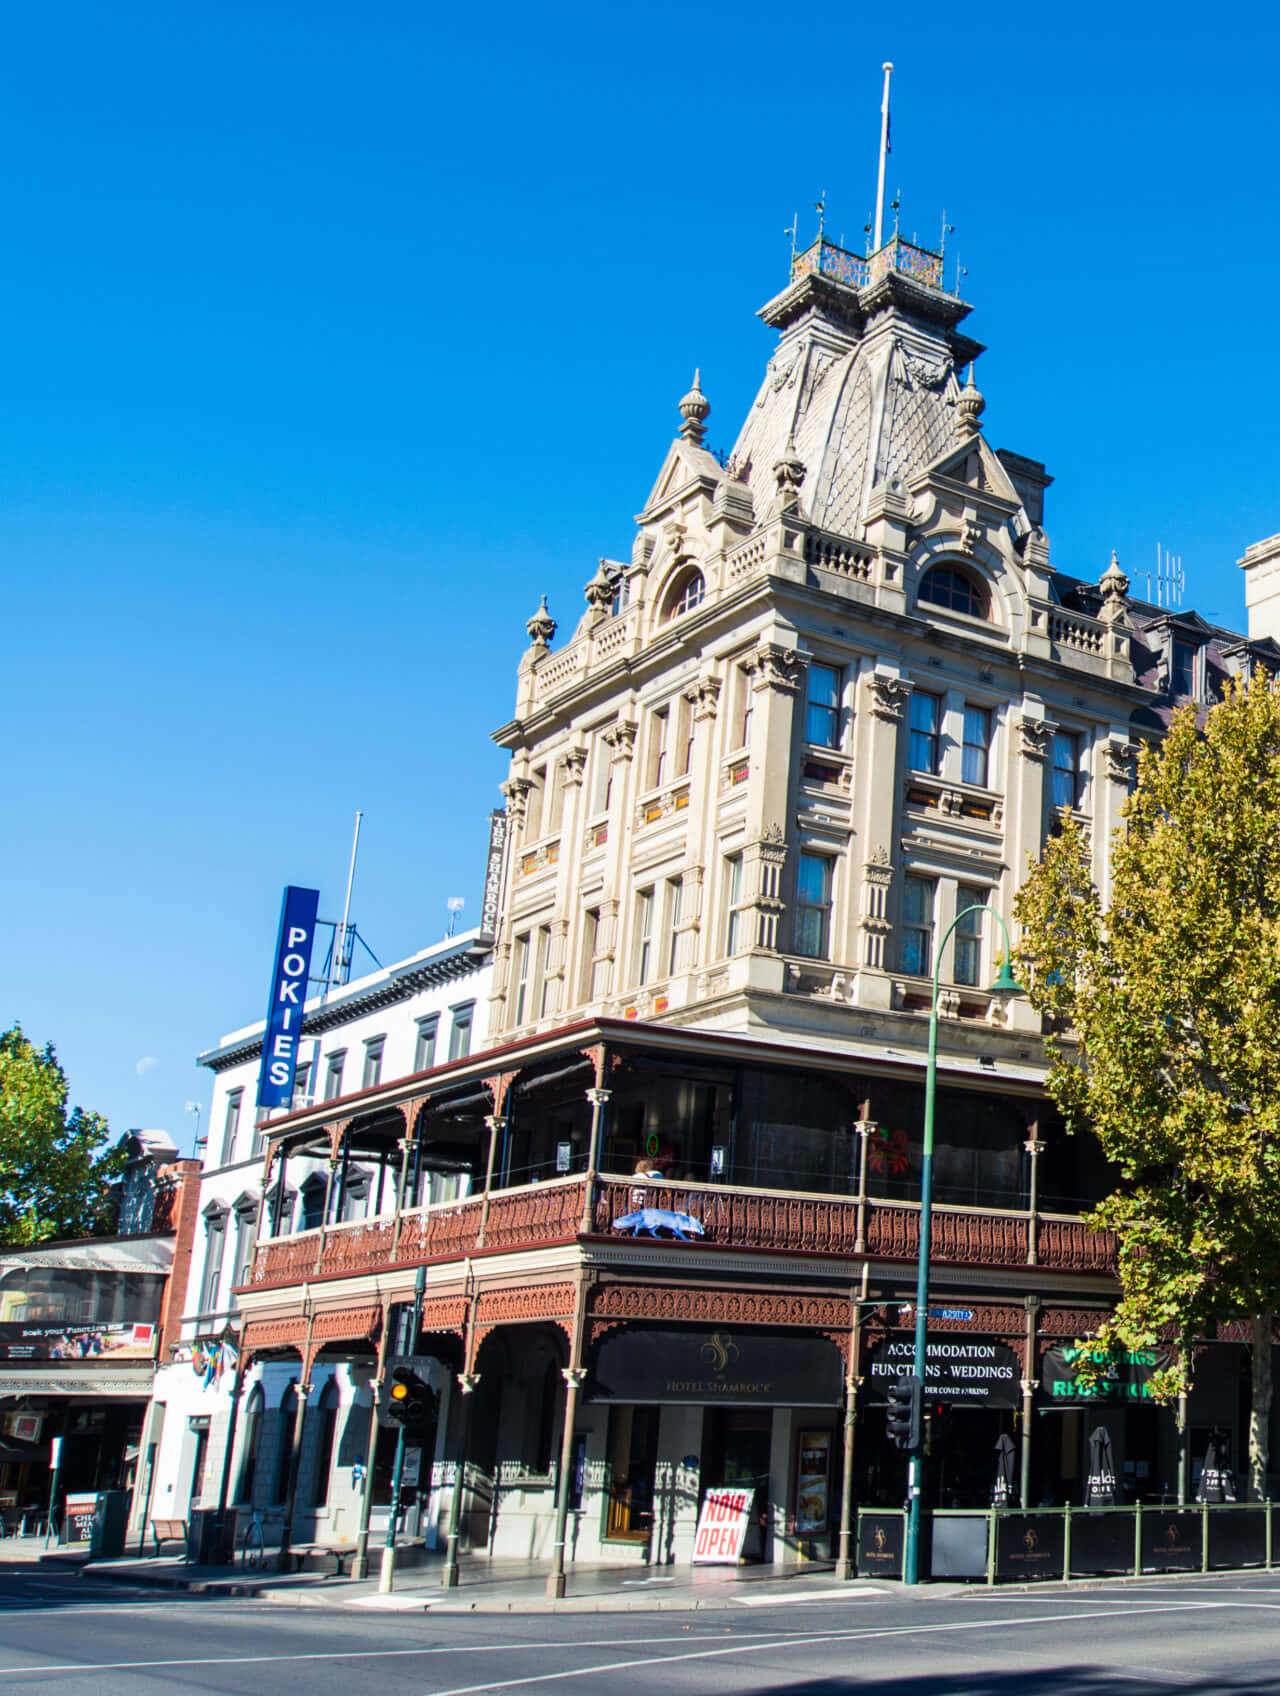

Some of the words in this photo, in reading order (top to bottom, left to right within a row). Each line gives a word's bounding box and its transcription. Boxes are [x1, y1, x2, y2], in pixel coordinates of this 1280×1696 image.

[491, 816, 506, 848] THE
[482, 852, 503, 934] SHAMROCK
[269, 927, 307, 1085] POKIES
[872, 1364, 940, 1377] FUNCTINS
[951, 1366, 1013, 1378] WEDDINGS
[1107, 1366, 1119, 1379] &
[666, 1382, 704, 1392] HOTEL
[709, 1383, 771, 1393] SHAMROCK
[705, 1495, 746, 1523] NOW
[696, 1528, 740, 1556] OPEN
